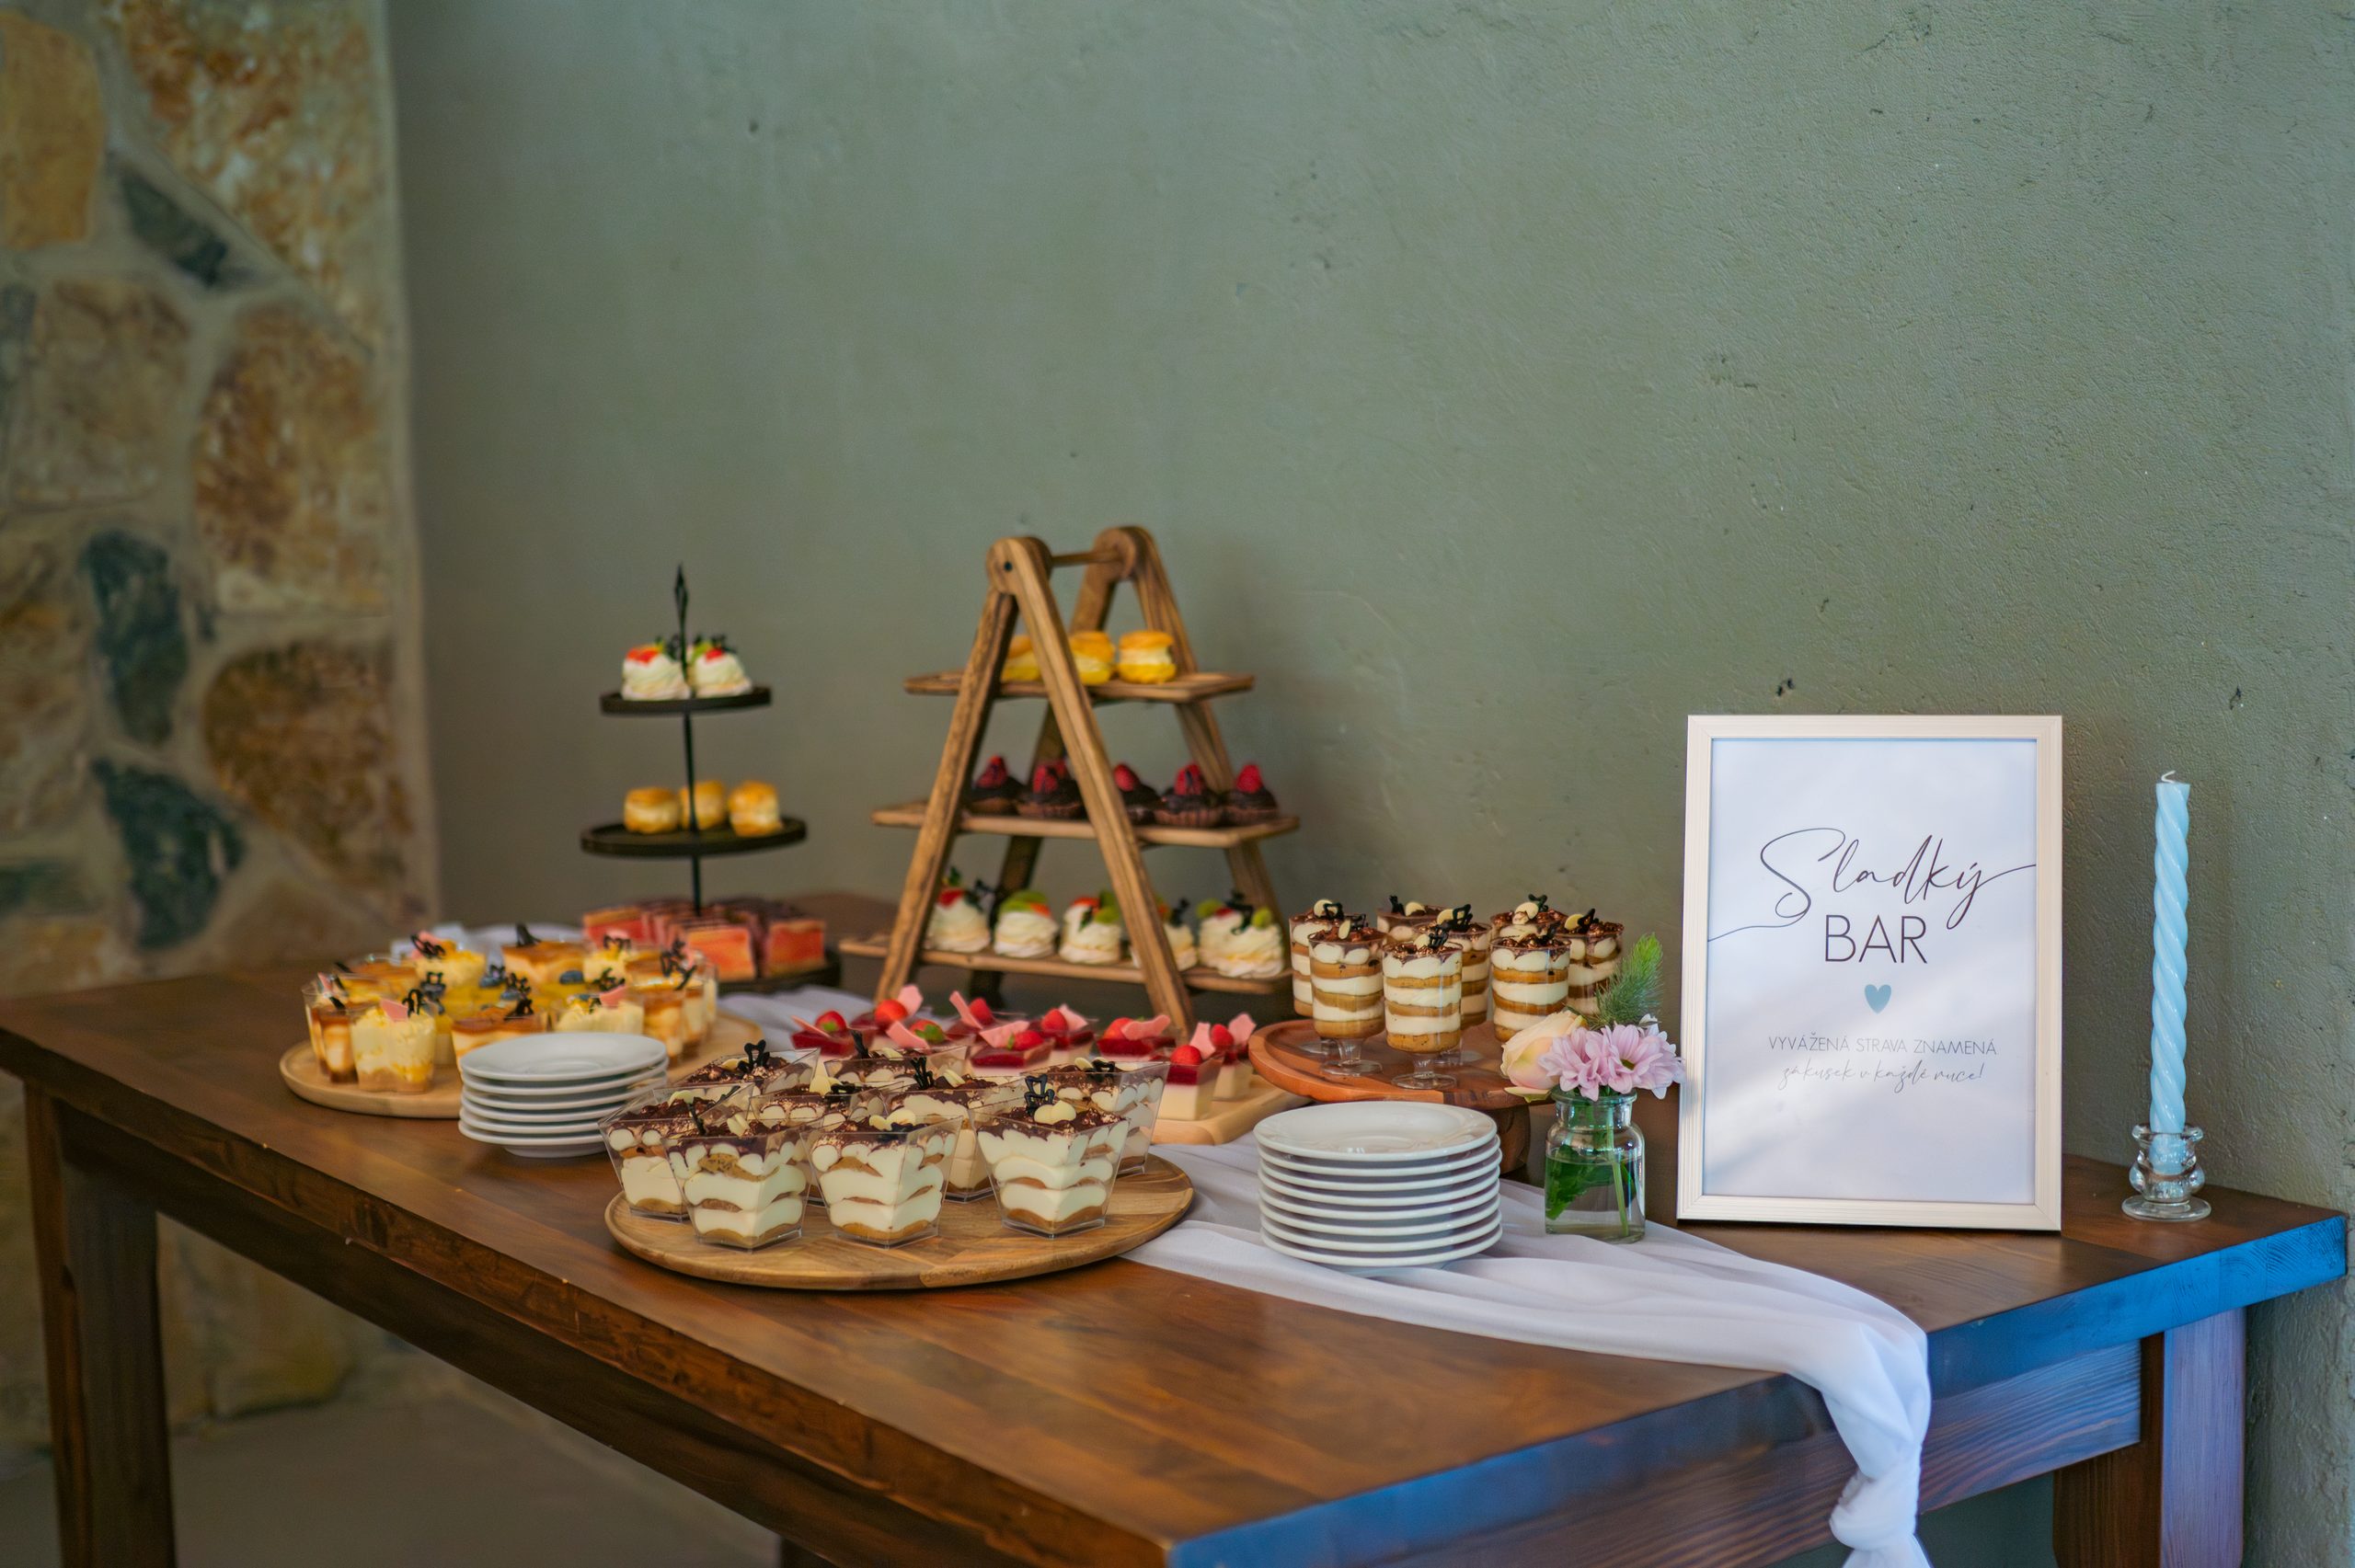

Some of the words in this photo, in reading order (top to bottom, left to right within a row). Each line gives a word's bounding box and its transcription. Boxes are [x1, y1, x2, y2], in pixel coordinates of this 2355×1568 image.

[1707, 827, 2036, 943] Sladký
[1824, 914, 1928, 964] BAR
[1768, 1031, 1849, 1052] VYVÁŽENÁ
[1855, 1037, 1908, 1053] STRAVA
[1913, 1038, 1997, 1056] ZNAMENÁ
